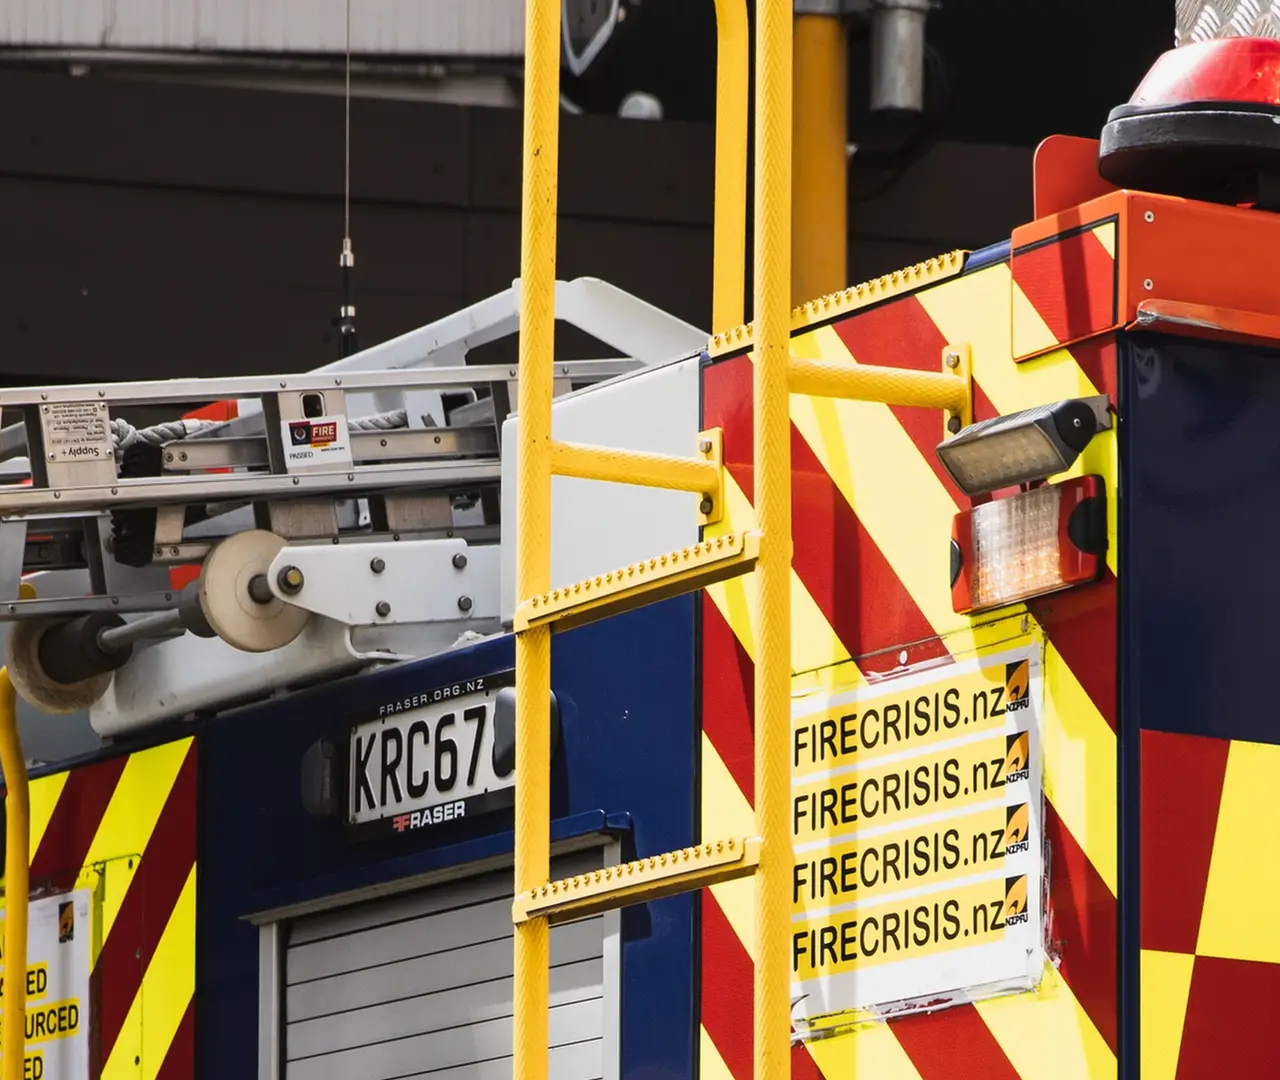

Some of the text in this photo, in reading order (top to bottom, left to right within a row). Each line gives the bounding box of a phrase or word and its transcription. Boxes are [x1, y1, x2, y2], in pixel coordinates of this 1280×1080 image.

[312, 425, 335, 436] FIRE
[379, 679, 484, 715] FRASER.ORG.NZ
[1006, 699, 1029, 713] NZPFU
[793, 686, 1006, 767] FIRECRISIS.nz
[1006, 770, 1029, 784] NZPFU
[793, 757, 1006, 835] FIRECRISIS.nz
[1006, 842, 1029, 855] NZPFU
[793, 828, 1006, 903] FIRECRISIS.nz
[1005, 913, 1029, 926] NZPFU
[793, 898, 1006, 972] FIRECRISIS.nz
